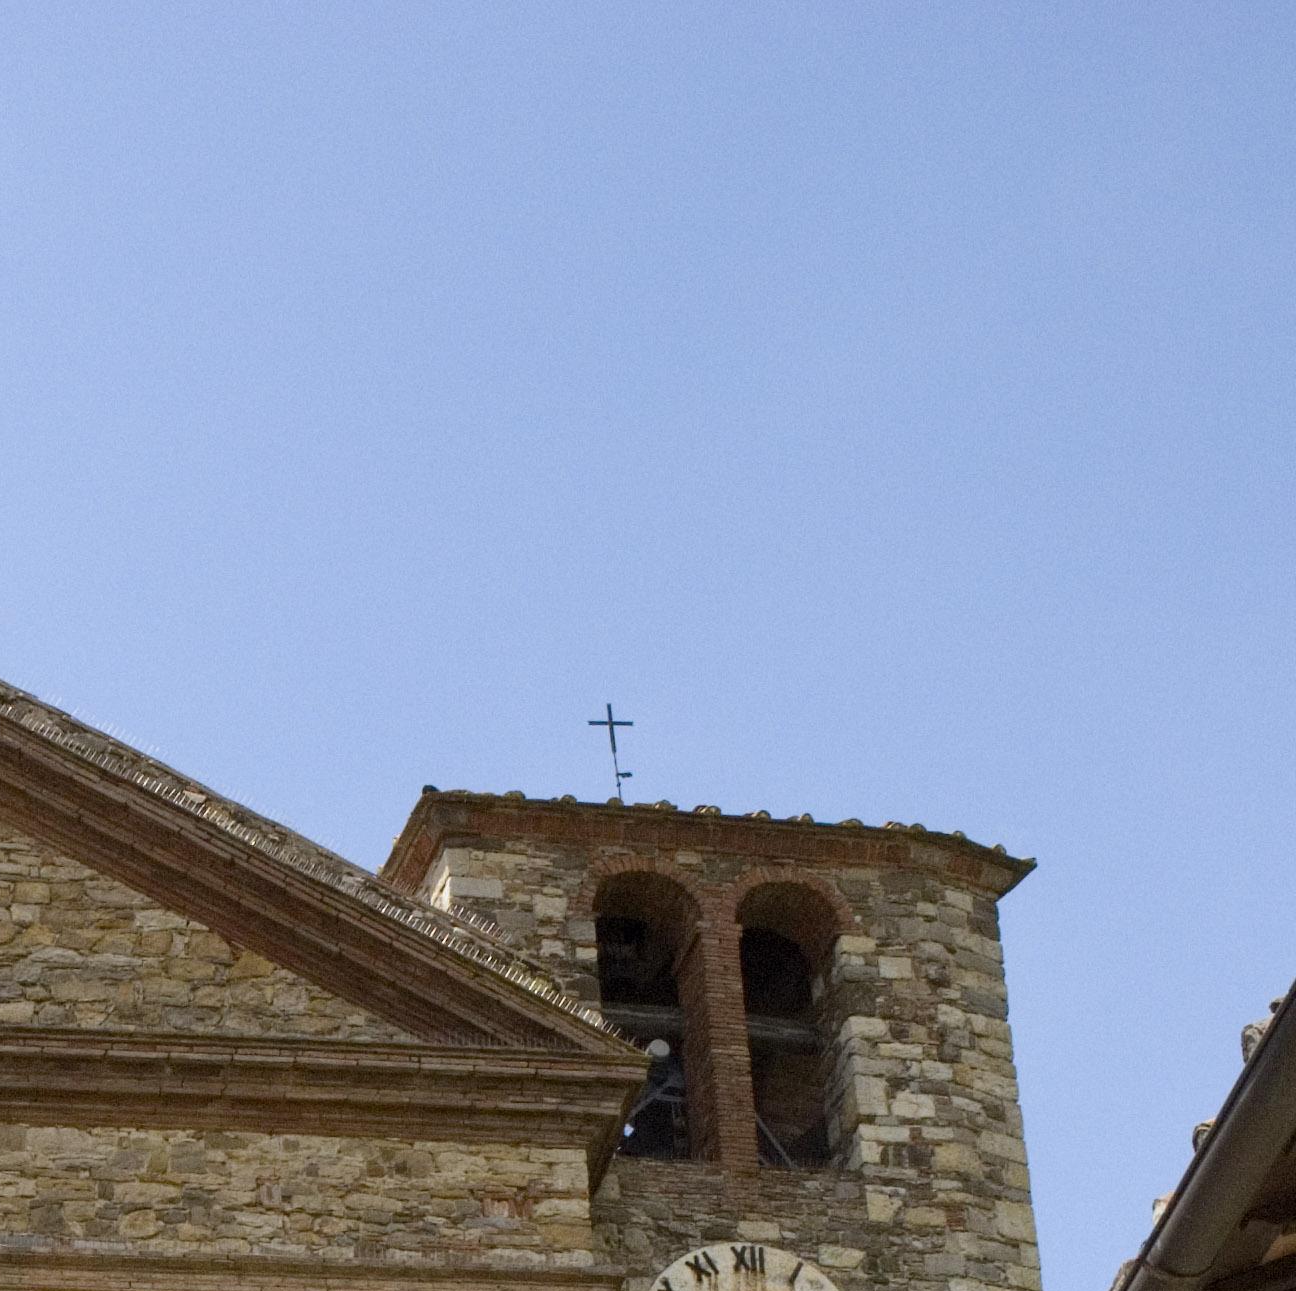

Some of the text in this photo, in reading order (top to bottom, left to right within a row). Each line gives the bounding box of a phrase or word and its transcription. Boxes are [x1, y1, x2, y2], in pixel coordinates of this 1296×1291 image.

[685, 1251, 719, 1281] XI
[731, 1246, 765, 1273] XII
[789, 1262, 803, 1283] I
